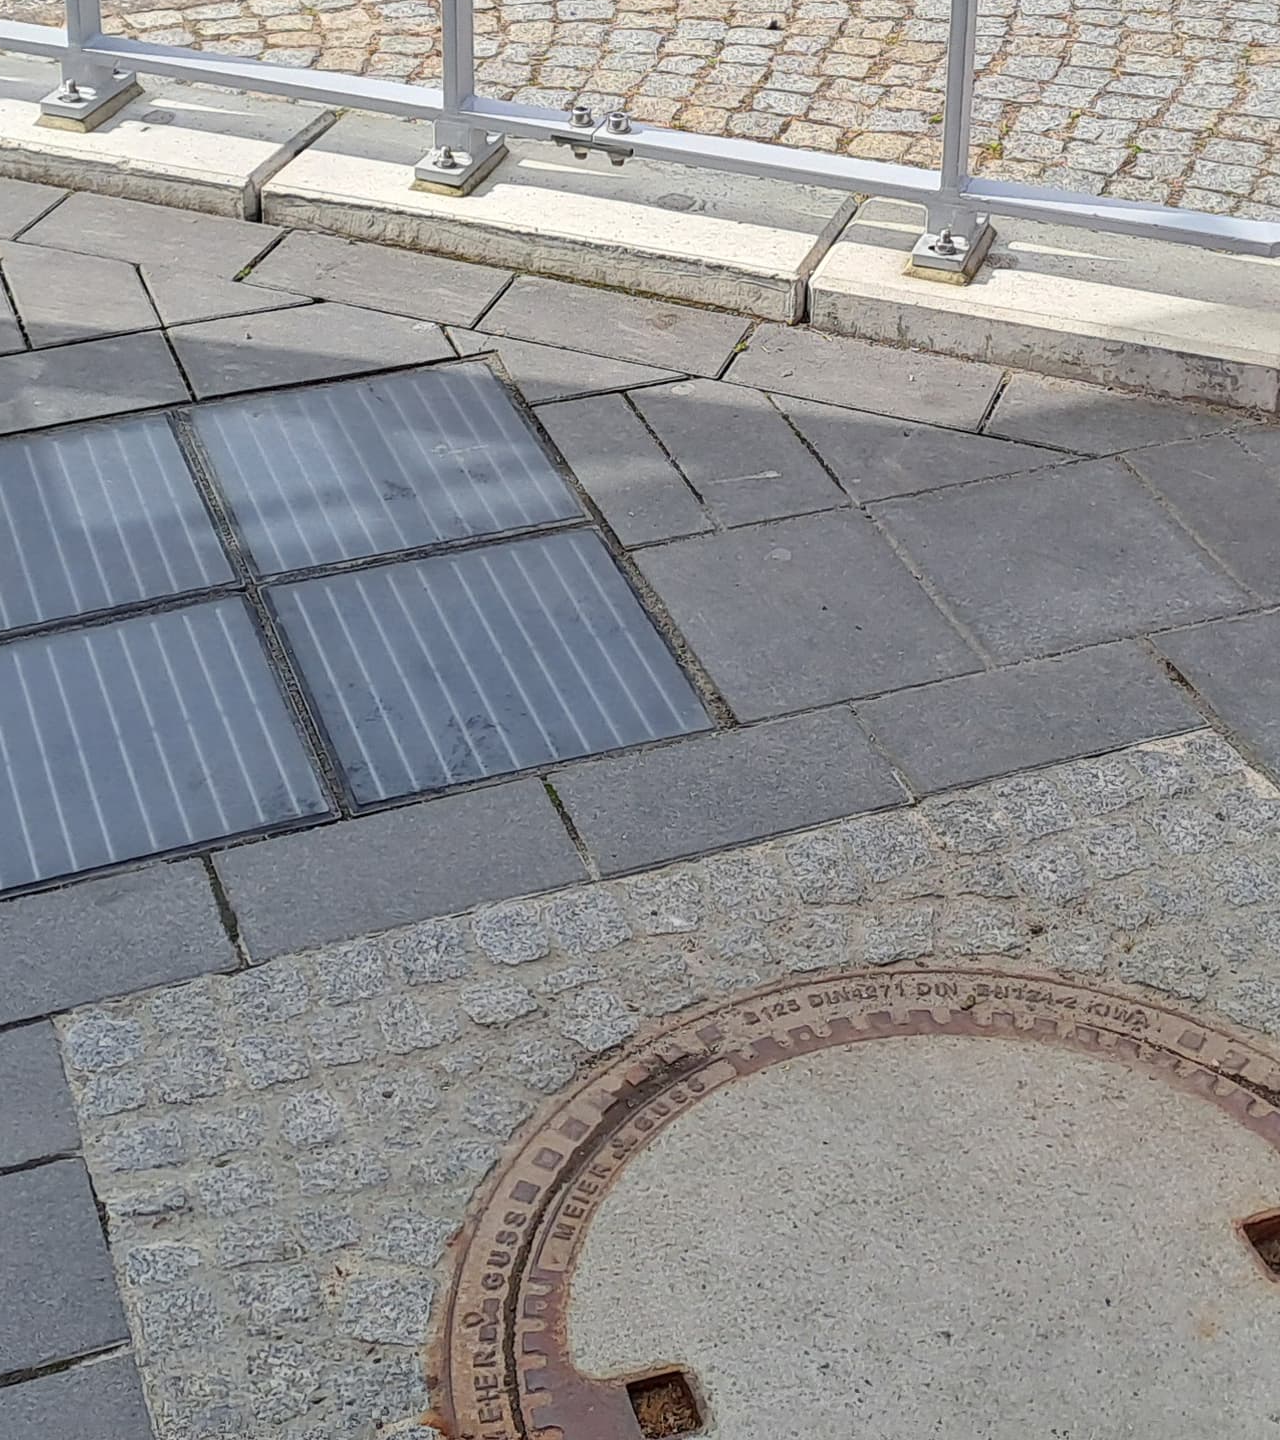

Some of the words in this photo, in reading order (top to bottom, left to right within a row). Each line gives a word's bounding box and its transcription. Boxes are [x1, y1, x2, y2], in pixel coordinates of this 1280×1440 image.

[552, 1163, 612, 1241] MEIER
[634, 1076, 706, 1132] GUSS
[480, 1210, 527, 1291] GUSS
